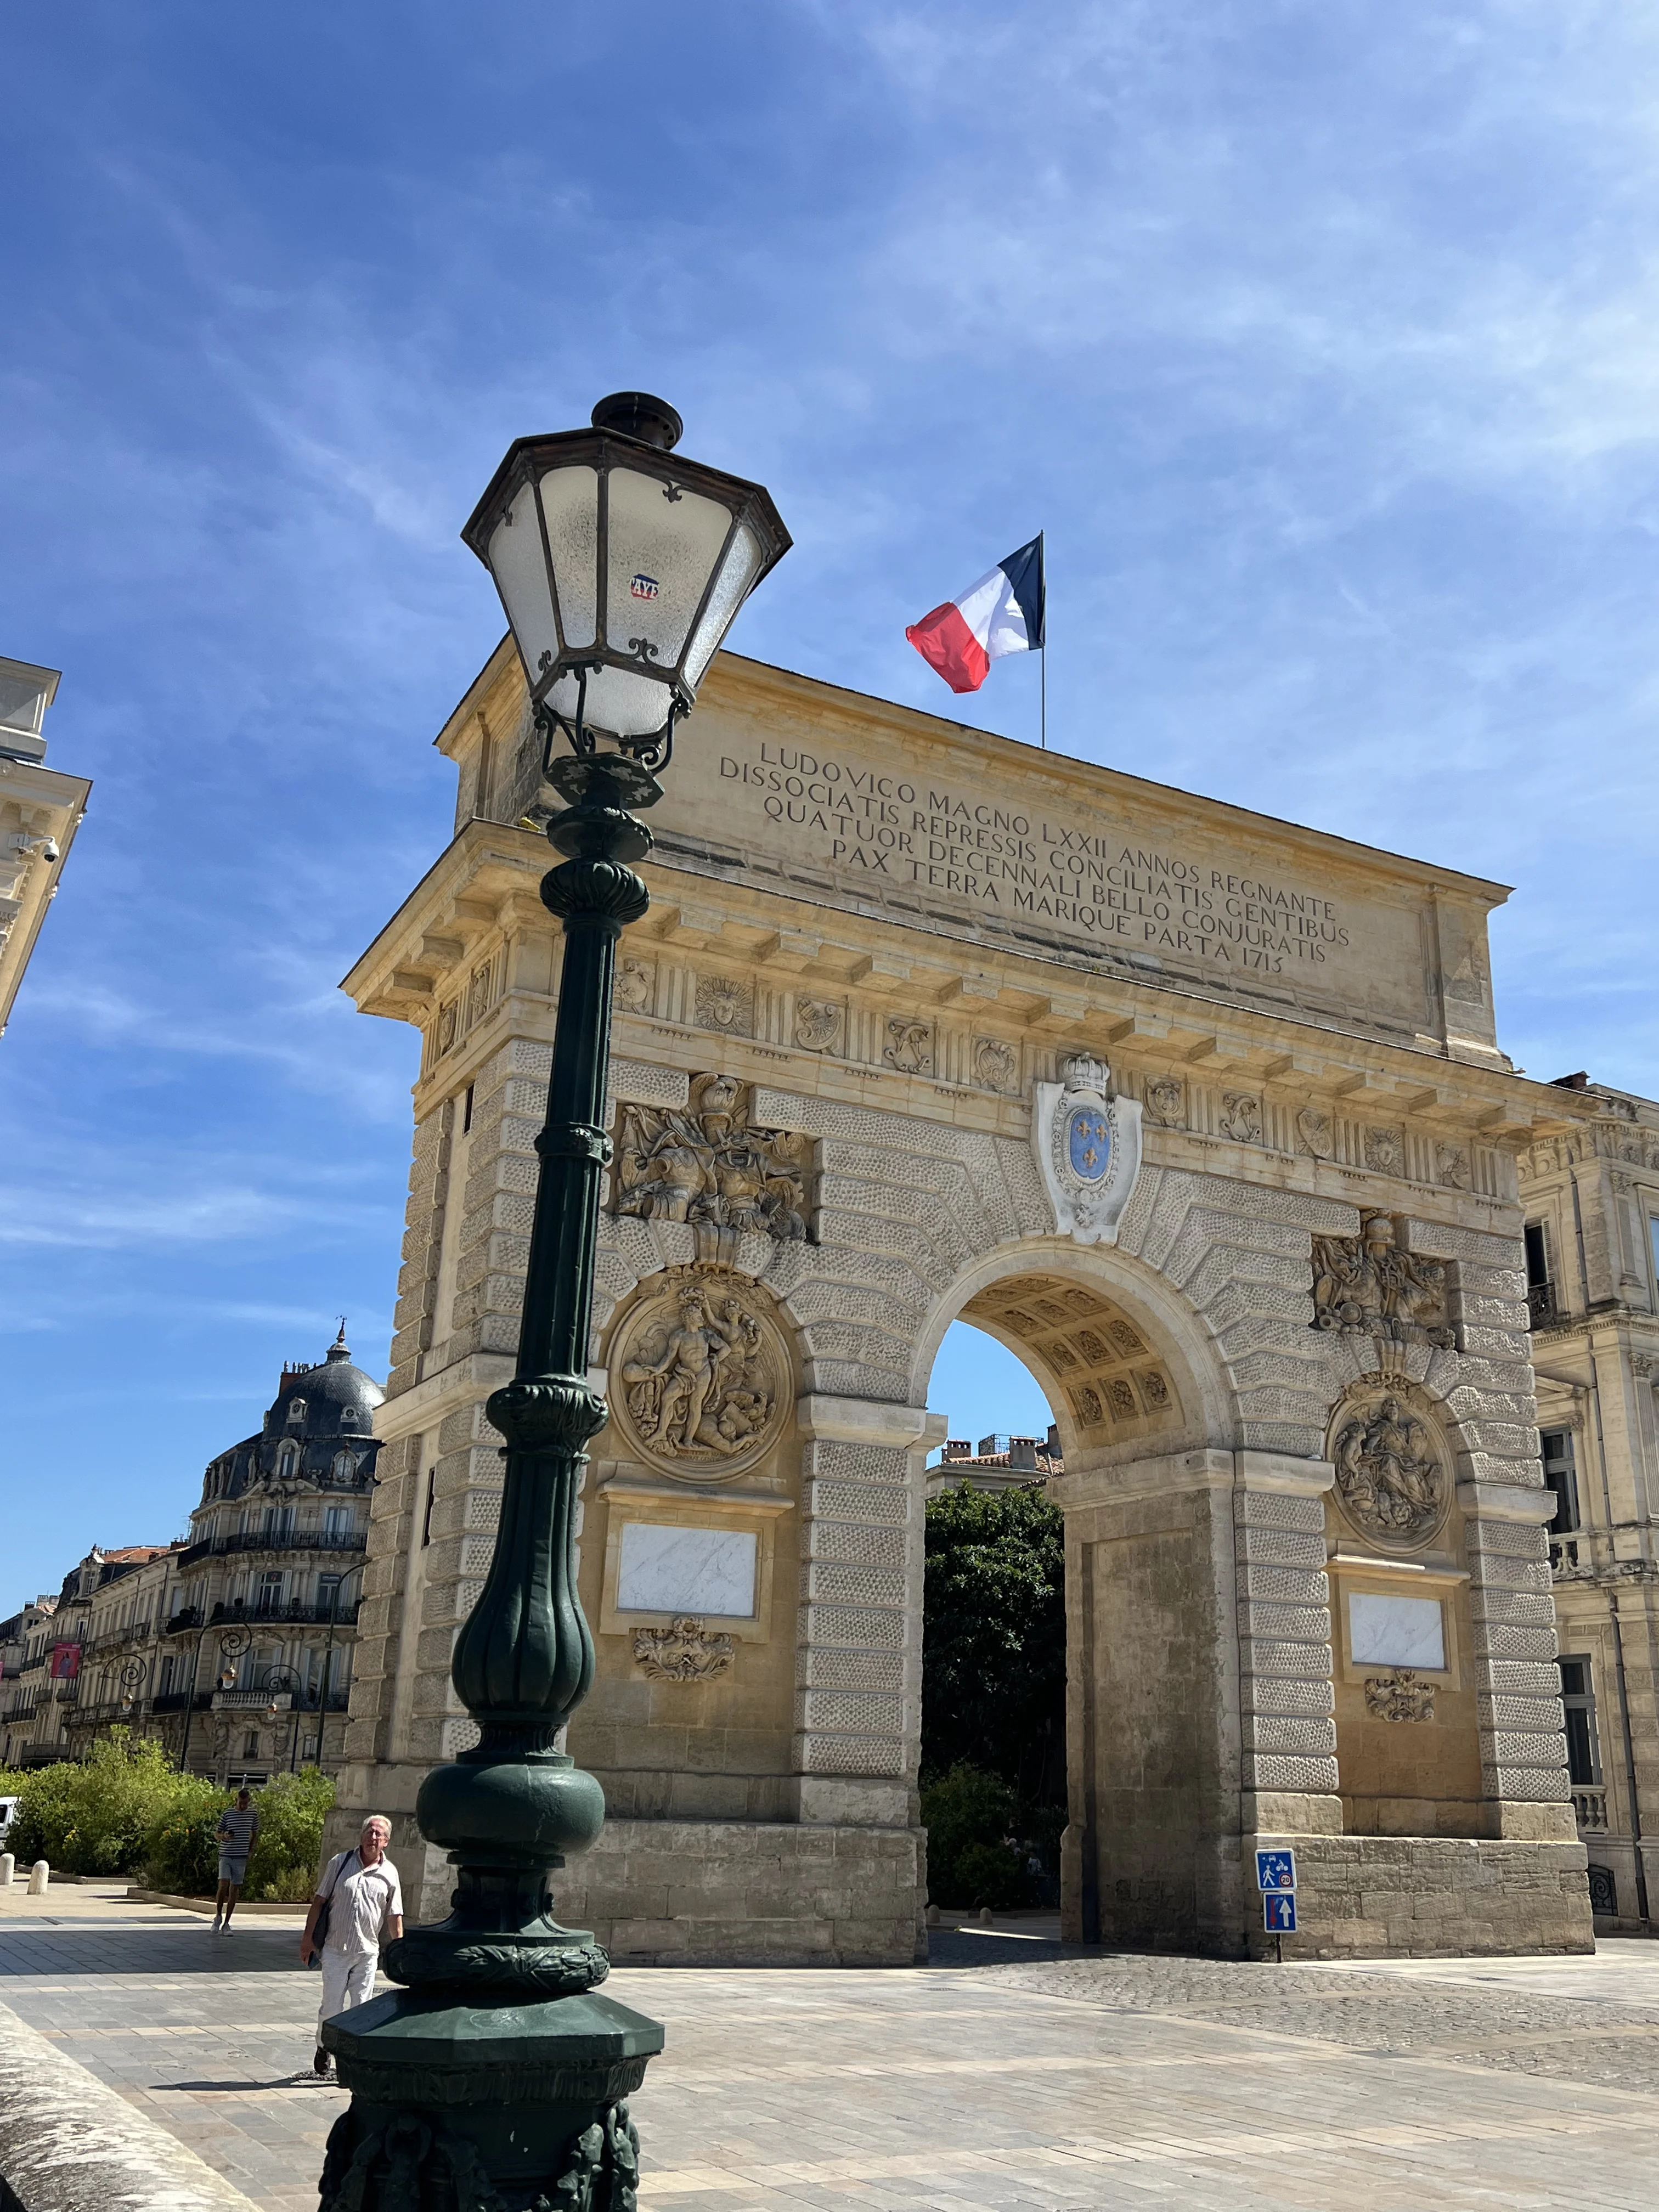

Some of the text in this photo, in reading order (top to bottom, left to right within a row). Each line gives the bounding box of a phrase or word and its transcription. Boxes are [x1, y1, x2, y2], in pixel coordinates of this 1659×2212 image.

[720, 757, 1349, 946] DISSOCIATIS REPRESSIS CONCILIATIS GENTIBUS
[760, 742, 1336, 921] LUDOVICO MAGNO LXXII ANNOS REGNANTE
[763, 797, 1325, 962] QUATUOR DECENNALI BELLO CONJURATIS
[832, 839, 1284, 973] PAX TERRA MARIQUE PARTA 1715
